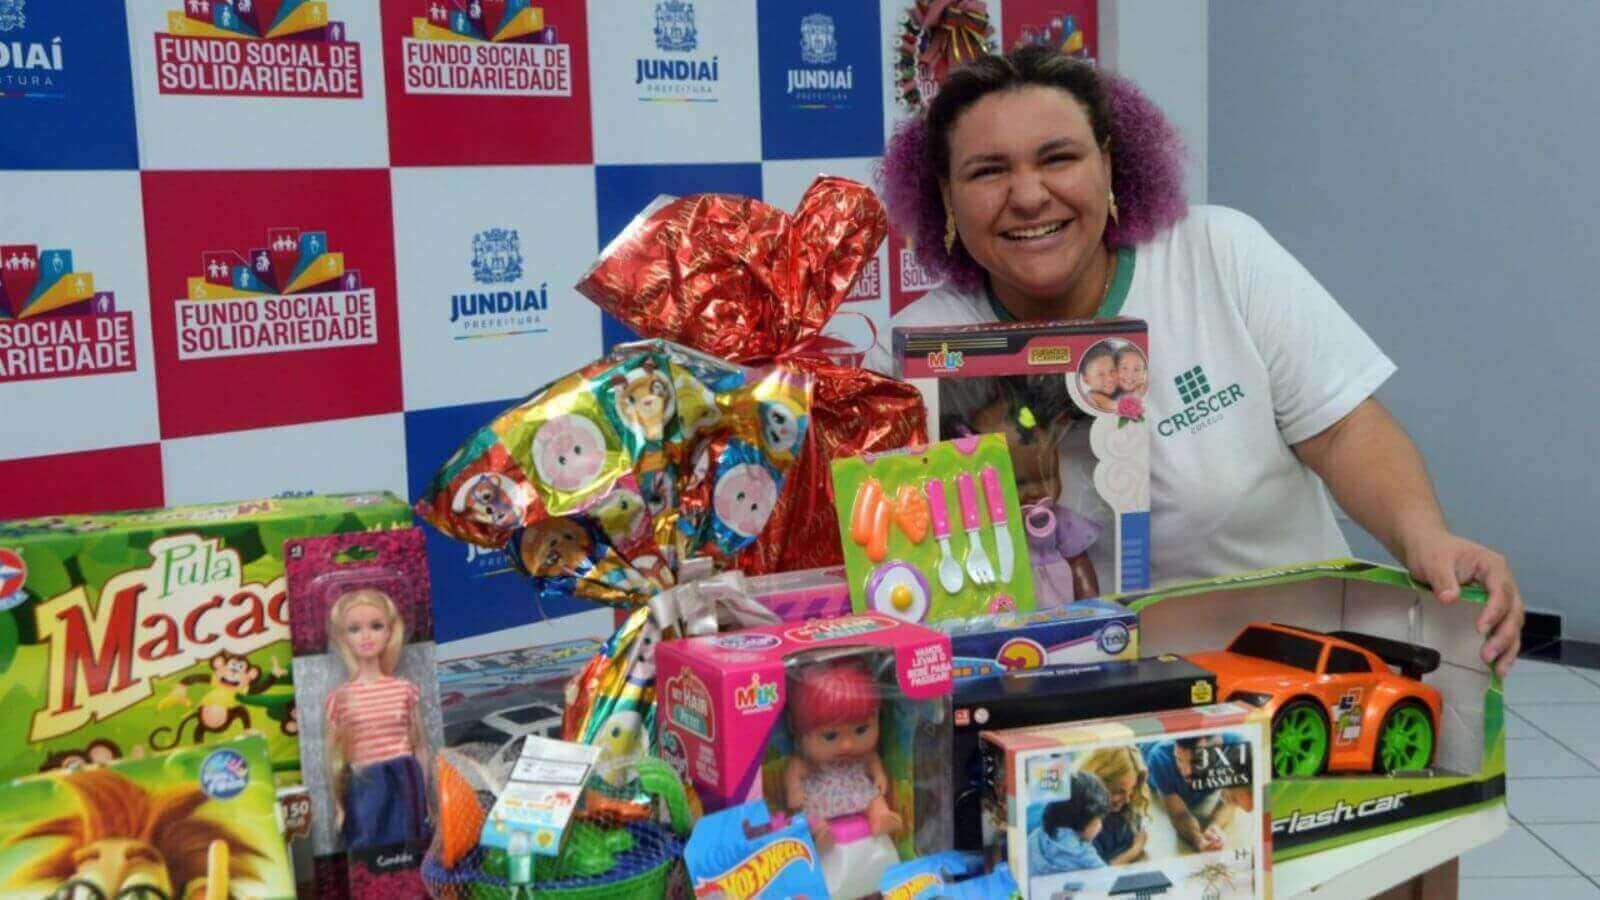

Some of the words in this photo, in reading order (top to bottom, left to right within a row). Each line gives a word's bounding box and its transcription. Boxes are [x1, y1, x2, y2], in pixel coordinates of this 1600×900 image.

[160, 38, 240, 64] FUNDO
[246, 41, 325, 67] SOCIAL
[329, 45, 357, 68] DE
[407, 43, 472, 65] FUNDO
[476, 45, 540, 68] SOCIAL
[544, 48, 566, 68] DE
[161, 62, 359, 93] SOLIDARIEDADE
[407, 65, 568, 91] SOLIDARIEDADE
[636, 56, 719, 84] JUNDIAÍ
[786, 65, 853, 94] JUNDIAÍ
[181, 301, 258, 327] FUNDO
[264, 296, 340, 322] SOCIAL
[344, 293, 371, 315] DE
[450, 282, 548, 322] JUNDIAÍ
[0, 318, 91, 349] SOCIAL
[96, 316, 129, 341] DE
[181, 316, 372, 353] SOLIDARIEDADE
[1157, 383, 1245, 436] CRESCER
[159, 543, 235, 599] Pula
